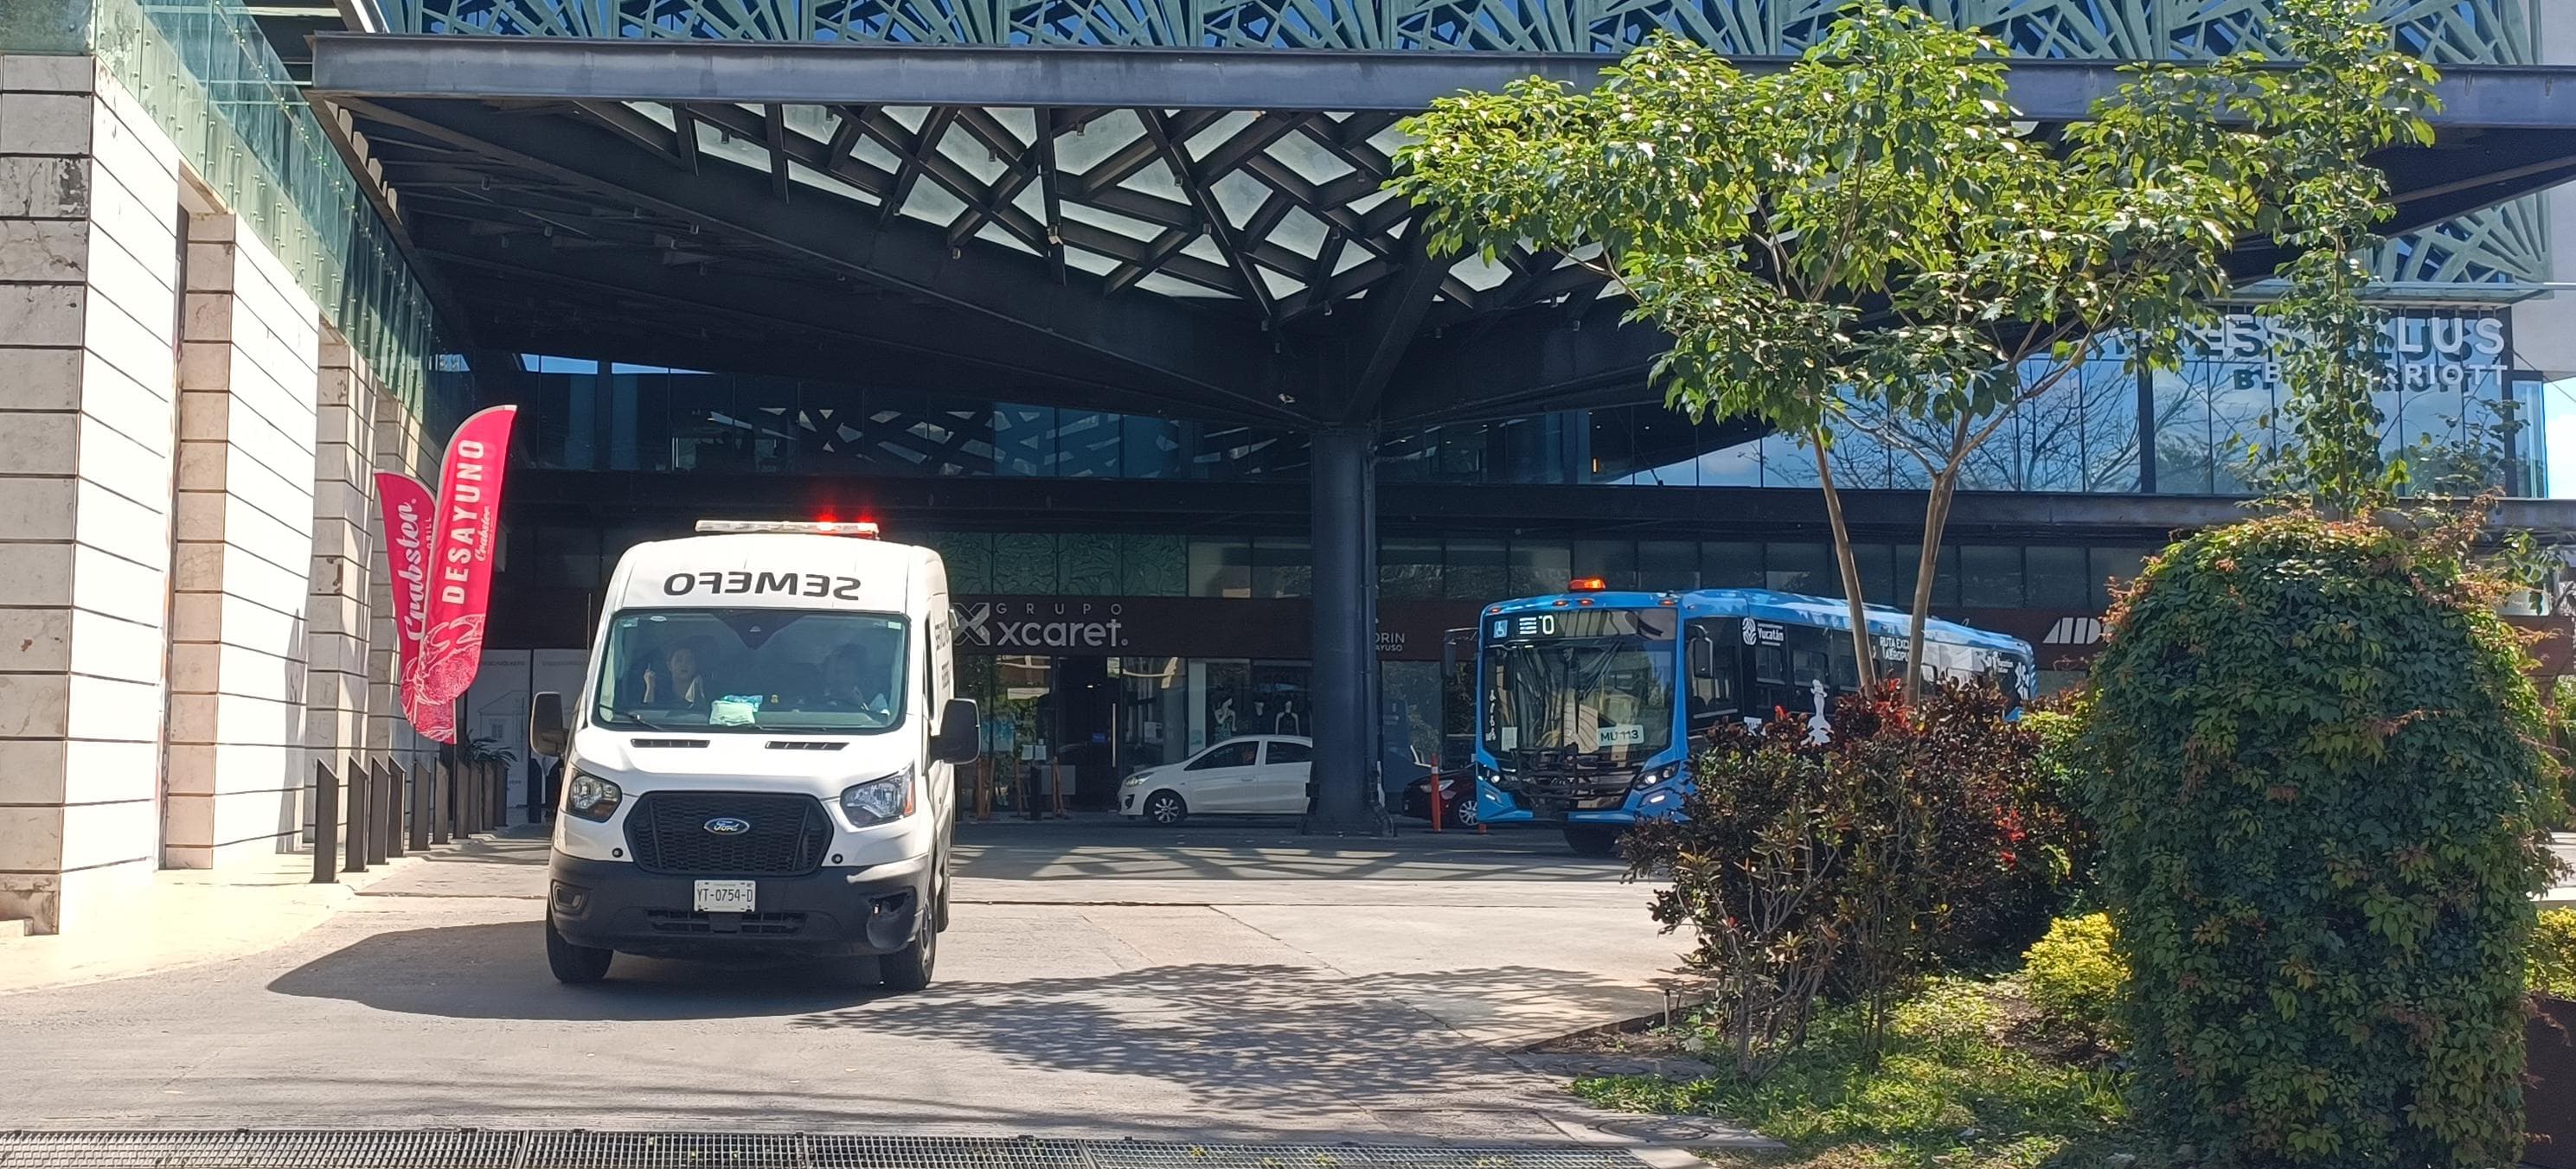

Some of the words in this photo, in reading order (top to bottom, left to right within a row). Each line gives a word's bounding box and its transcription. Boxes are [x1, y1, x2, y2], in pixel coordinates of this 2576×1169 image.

[2396, 316, 2505, 355] LUS
[442, 438, 484, 605] DESAYUNO
[996, 603, 1122, 615] GRUPO
[697, 888, 753, 903] YT-0754-D
